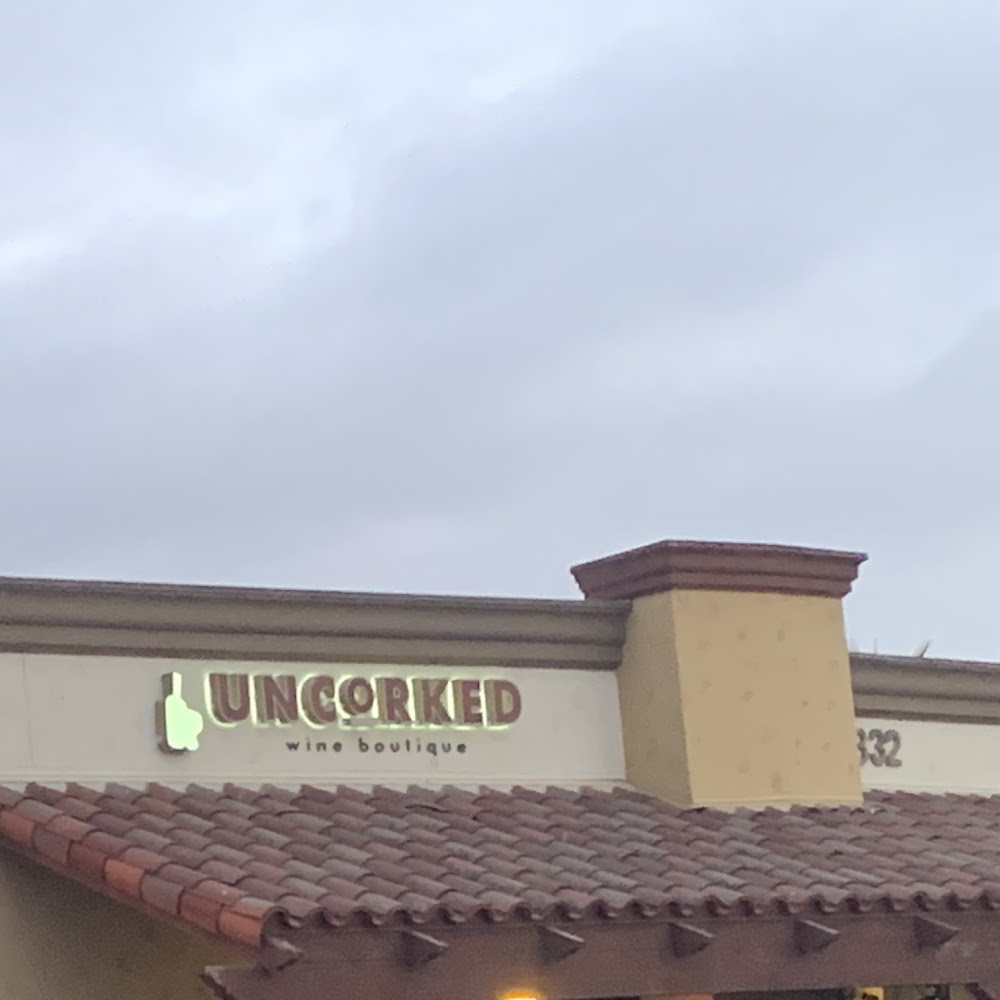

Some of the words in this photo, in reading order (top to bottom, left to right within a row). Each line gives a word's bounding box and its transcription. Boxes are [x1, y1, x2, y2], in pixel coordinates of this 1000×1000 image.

[208, 672, 522, 726] UNCORKED
[285, 738, 344, 753] wine
[358, 738, 468, 757] boutique
